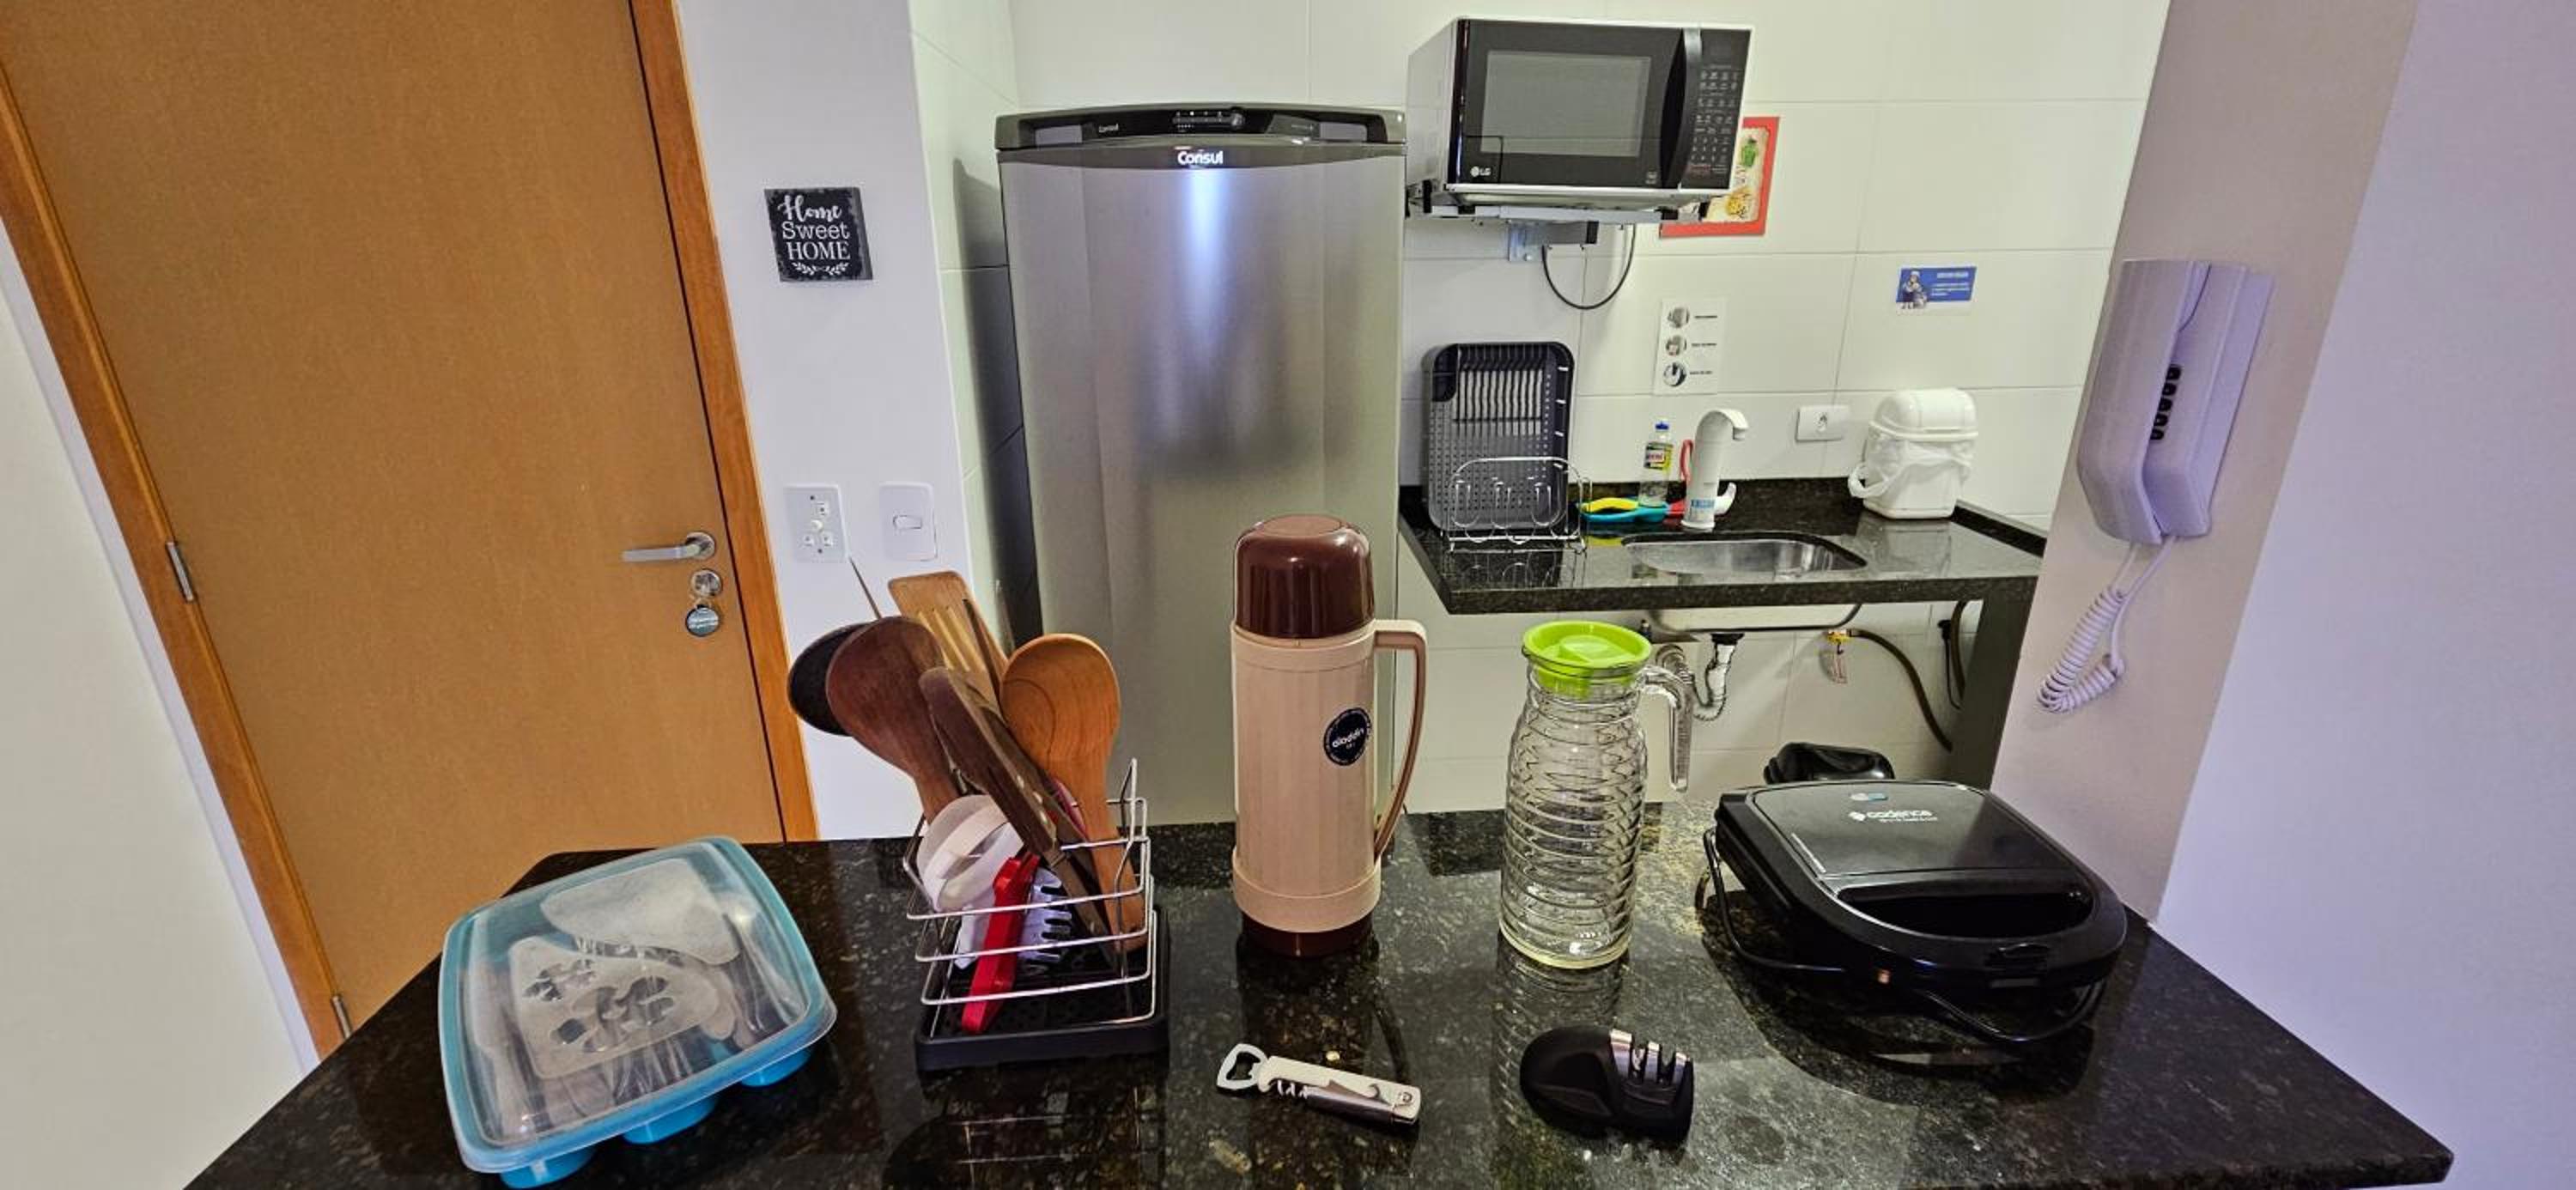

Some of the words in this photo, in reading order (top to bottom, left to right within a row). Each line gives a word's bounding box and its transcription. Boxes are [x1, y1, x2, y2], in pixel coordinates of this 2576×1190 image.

[1177, 150, 1224, 165] Consul
[777, 195, 841, 222] Home
[781, 221, 850, 240] Sweet
[786, 241, 851, 260] HOME
[1866, 810, 1933, 818] cadence
